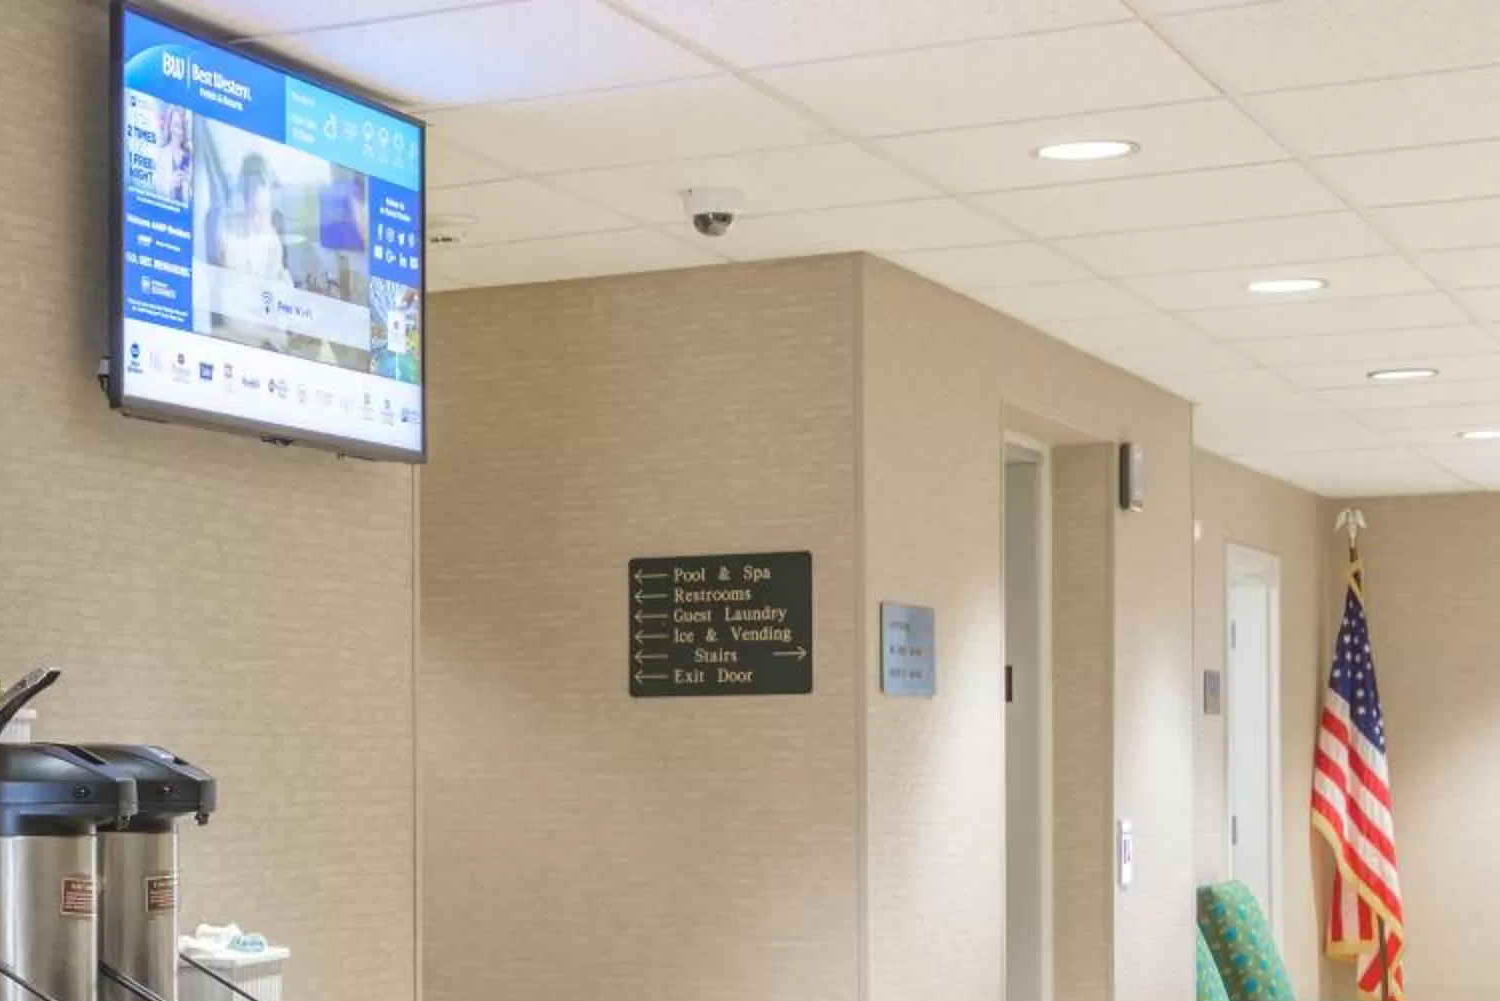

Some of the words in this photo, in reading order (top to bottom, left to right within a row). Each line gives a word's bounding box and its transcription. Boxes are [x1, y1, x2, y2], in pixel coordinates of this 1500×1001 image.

[192, 64, 213, 87] Best
[213, 71, 251, 100] Western
[673, 567, 706, 583] Pool
[718, 565, 731, 581] &
[742, 564, 771, 583] Spa
[674, 587, 752, 603] Restrooms
[673, 608, 712, 623] Guest
[724, 605, 787, 623] Laundry
[673, 628, 695, 643] Ice
[705, 627, 718, 643] &
[729, 625, 793, 643] Vending
[694, 647, 738, 663] Stairs
[673, 668, 705, 684] Exit
[716, 667, 753, 683] Door
